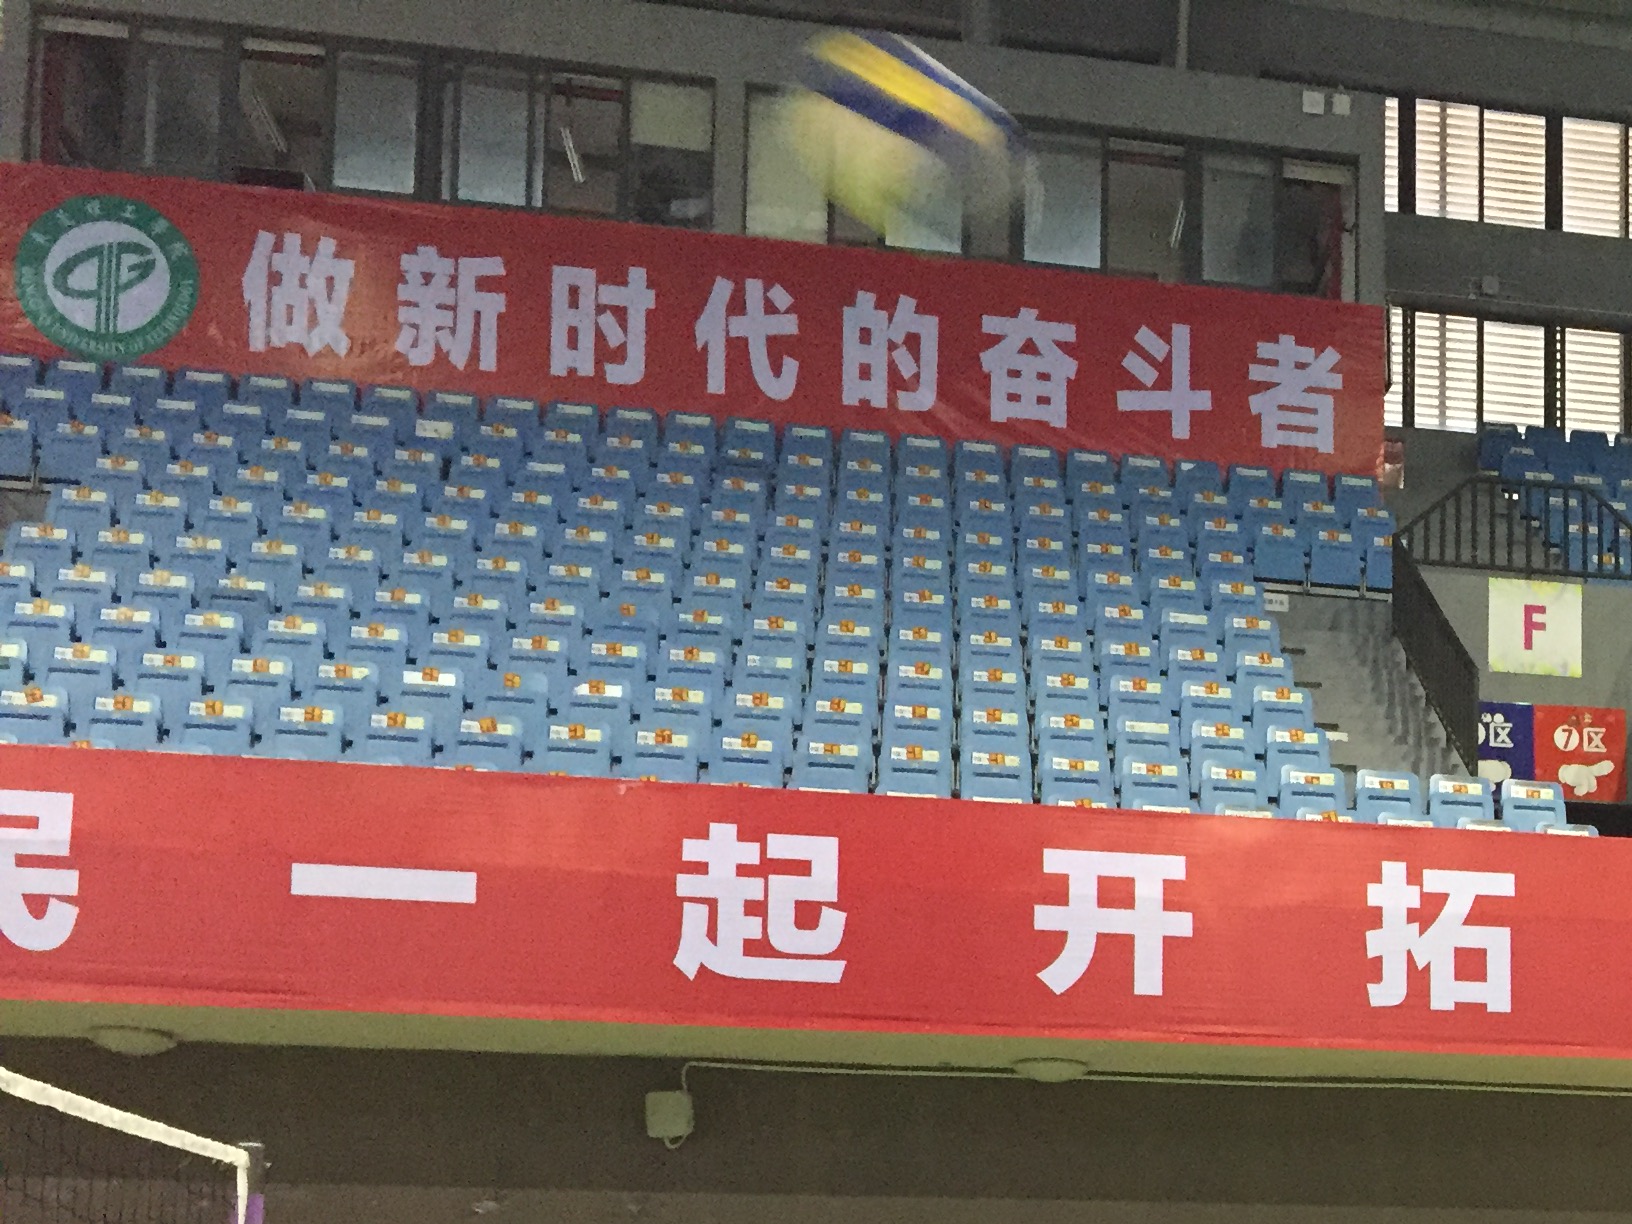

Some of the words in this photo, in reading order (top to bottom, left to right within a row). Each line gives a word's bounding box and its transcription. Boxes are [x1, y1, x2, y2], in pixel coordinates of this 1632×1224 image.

[242, 229, 1344, 454] 做新时代的奋斗者
[1523, 604, 1547, 651] F
[1478, 722, 1514, 748] 区
